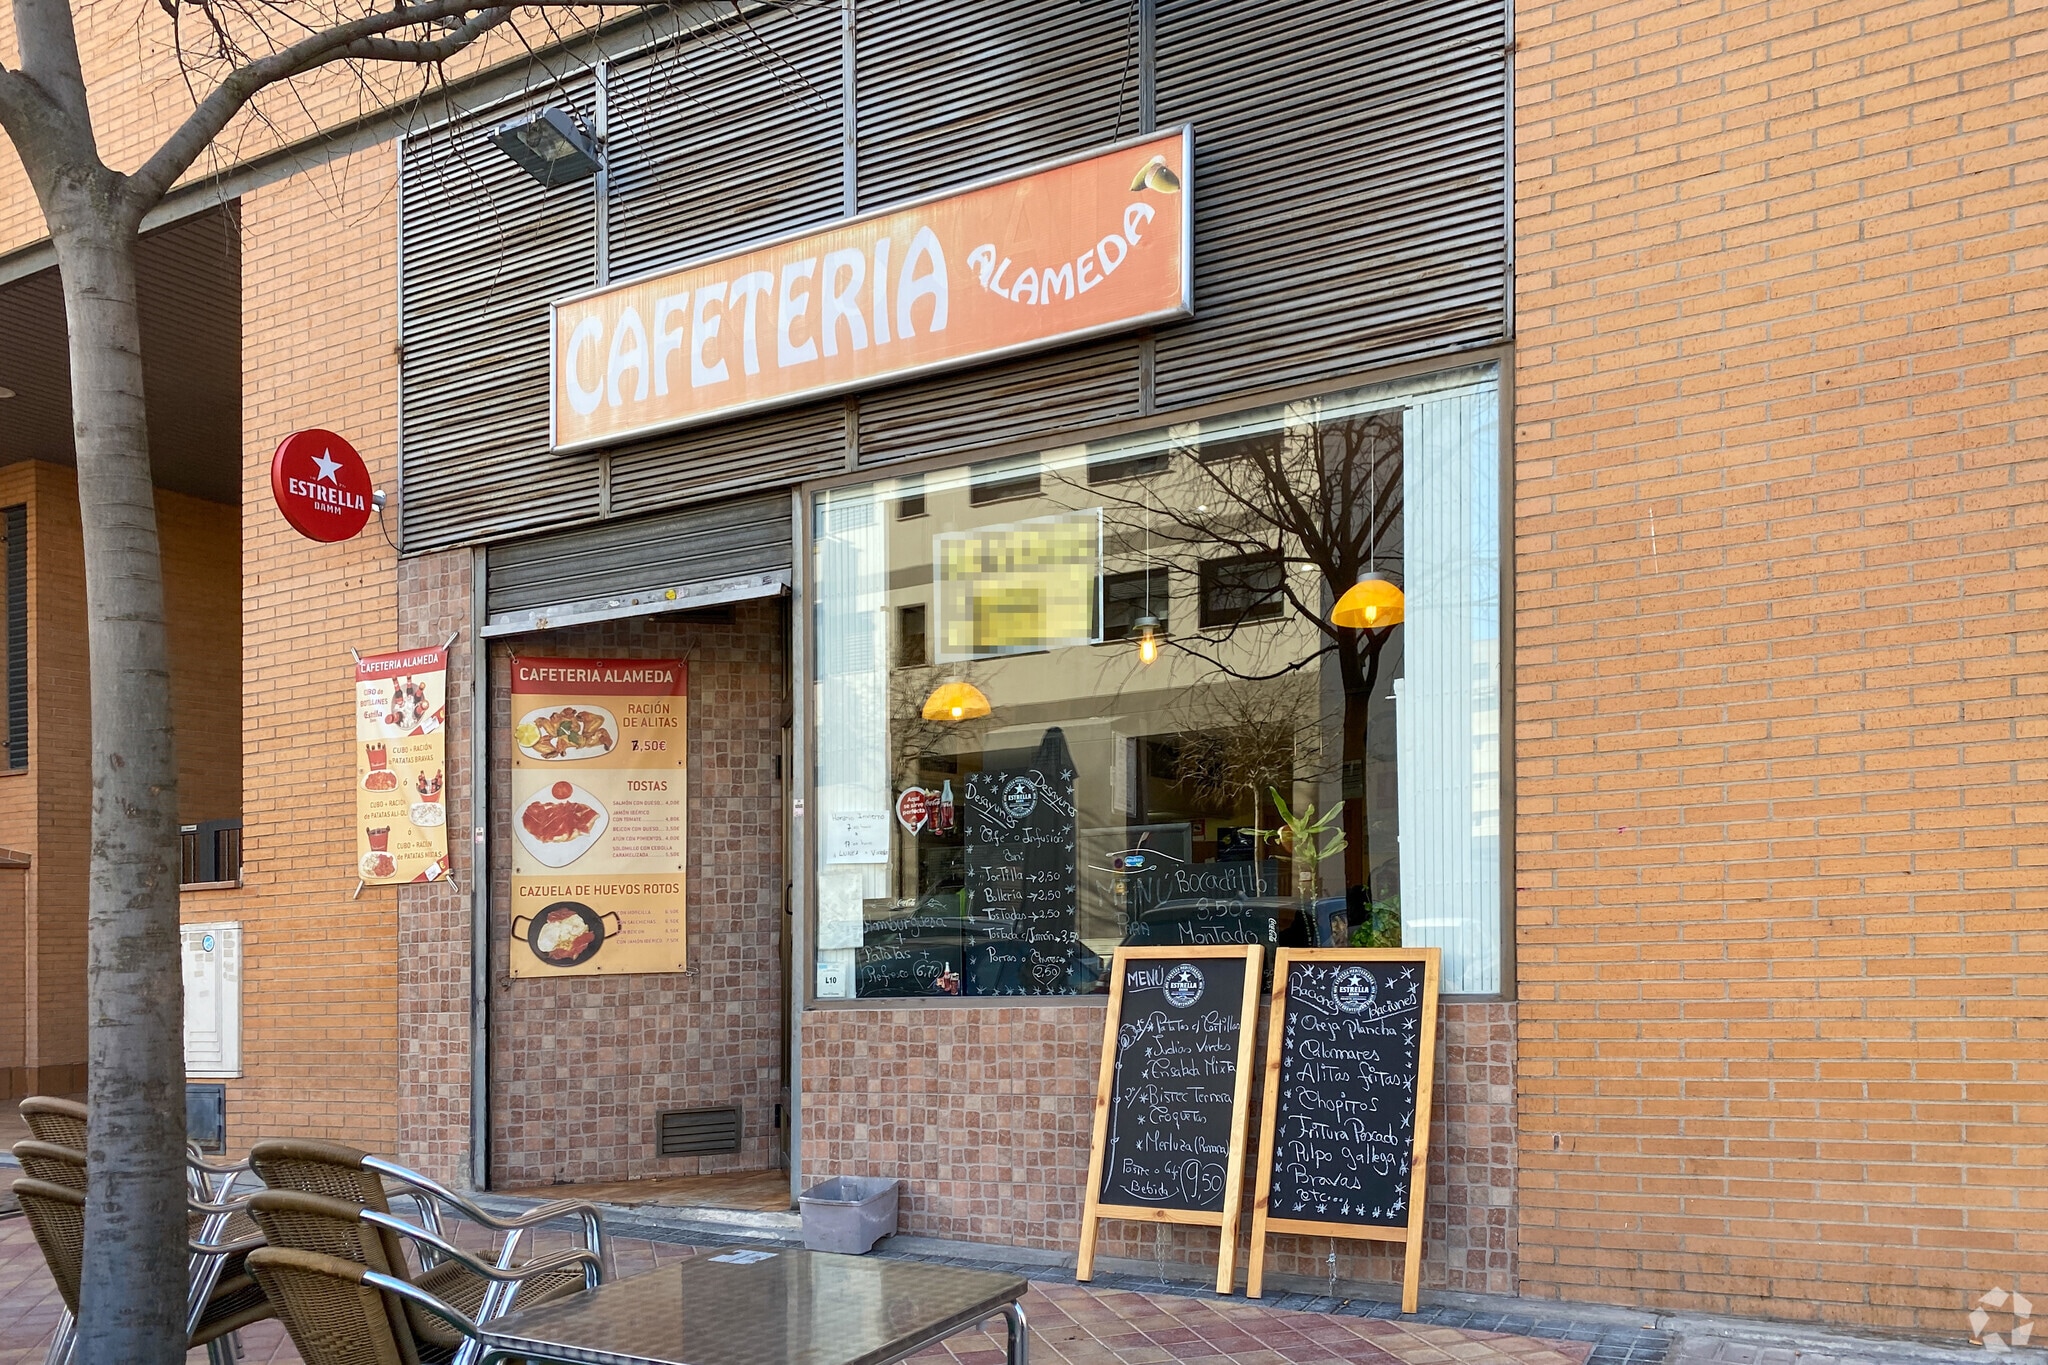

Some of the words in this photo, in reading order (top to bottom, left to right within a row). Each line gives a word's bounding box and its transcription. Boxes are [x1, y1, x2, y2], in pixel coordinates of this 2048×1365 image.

[565, 225, 949, 416] CAFETERIA
[967, 202, 1156, 307] ALAMEDA
[289, 477, 365, 511] ESTRELLA
[314, 501, 342, 516] DAMM
[360, 659, 401, 674] CAFETERIA
[402, 653, 439, 667] ALAMEDA
[520, 668, 601, 682] CAFETERIA
[604, 670, 674, 683] ALAMEDA
[628, 700, 670, 714] RACIÓN
[623, 717, 637, 728] DE
[641, 717, 678, 728] ALITAS
[414, 742, 432, 752] RACIÓN
[415, 754, 434, 763] BRAVAS
[627, 781, 668, 791] TOSTAS
[980, 866, 1024, 882] Tortilla
[1037, 870, 1060, 883] 2,50
[1174, 864, 1268, 894] Bocadillo
[519, 885, 572, 897] CAZUELA
[575, 885, 591, 896] DE
[594, 884, 641, 895] HUEVOS
[643, 883, 680, 894] ROTOS
[1038, 890, 1061, 902] 2,50
[982, 906, 1027, 920] Tostadas
[1038, 910, 1060, 919] 2,50
[1178, 920, 1258, 944] Montado
[1034, 968, 1058, 978] 2,50
[1127, 965, 1164, 988] MENÚ
[1300, 1015, 1341, 1042] Oreja
[1300, 1039, 1380, 1061] Calamares
[1296, 1062, 1350, 1084] Alitas
[1186, 1161, 1222, 1200] 9,50
